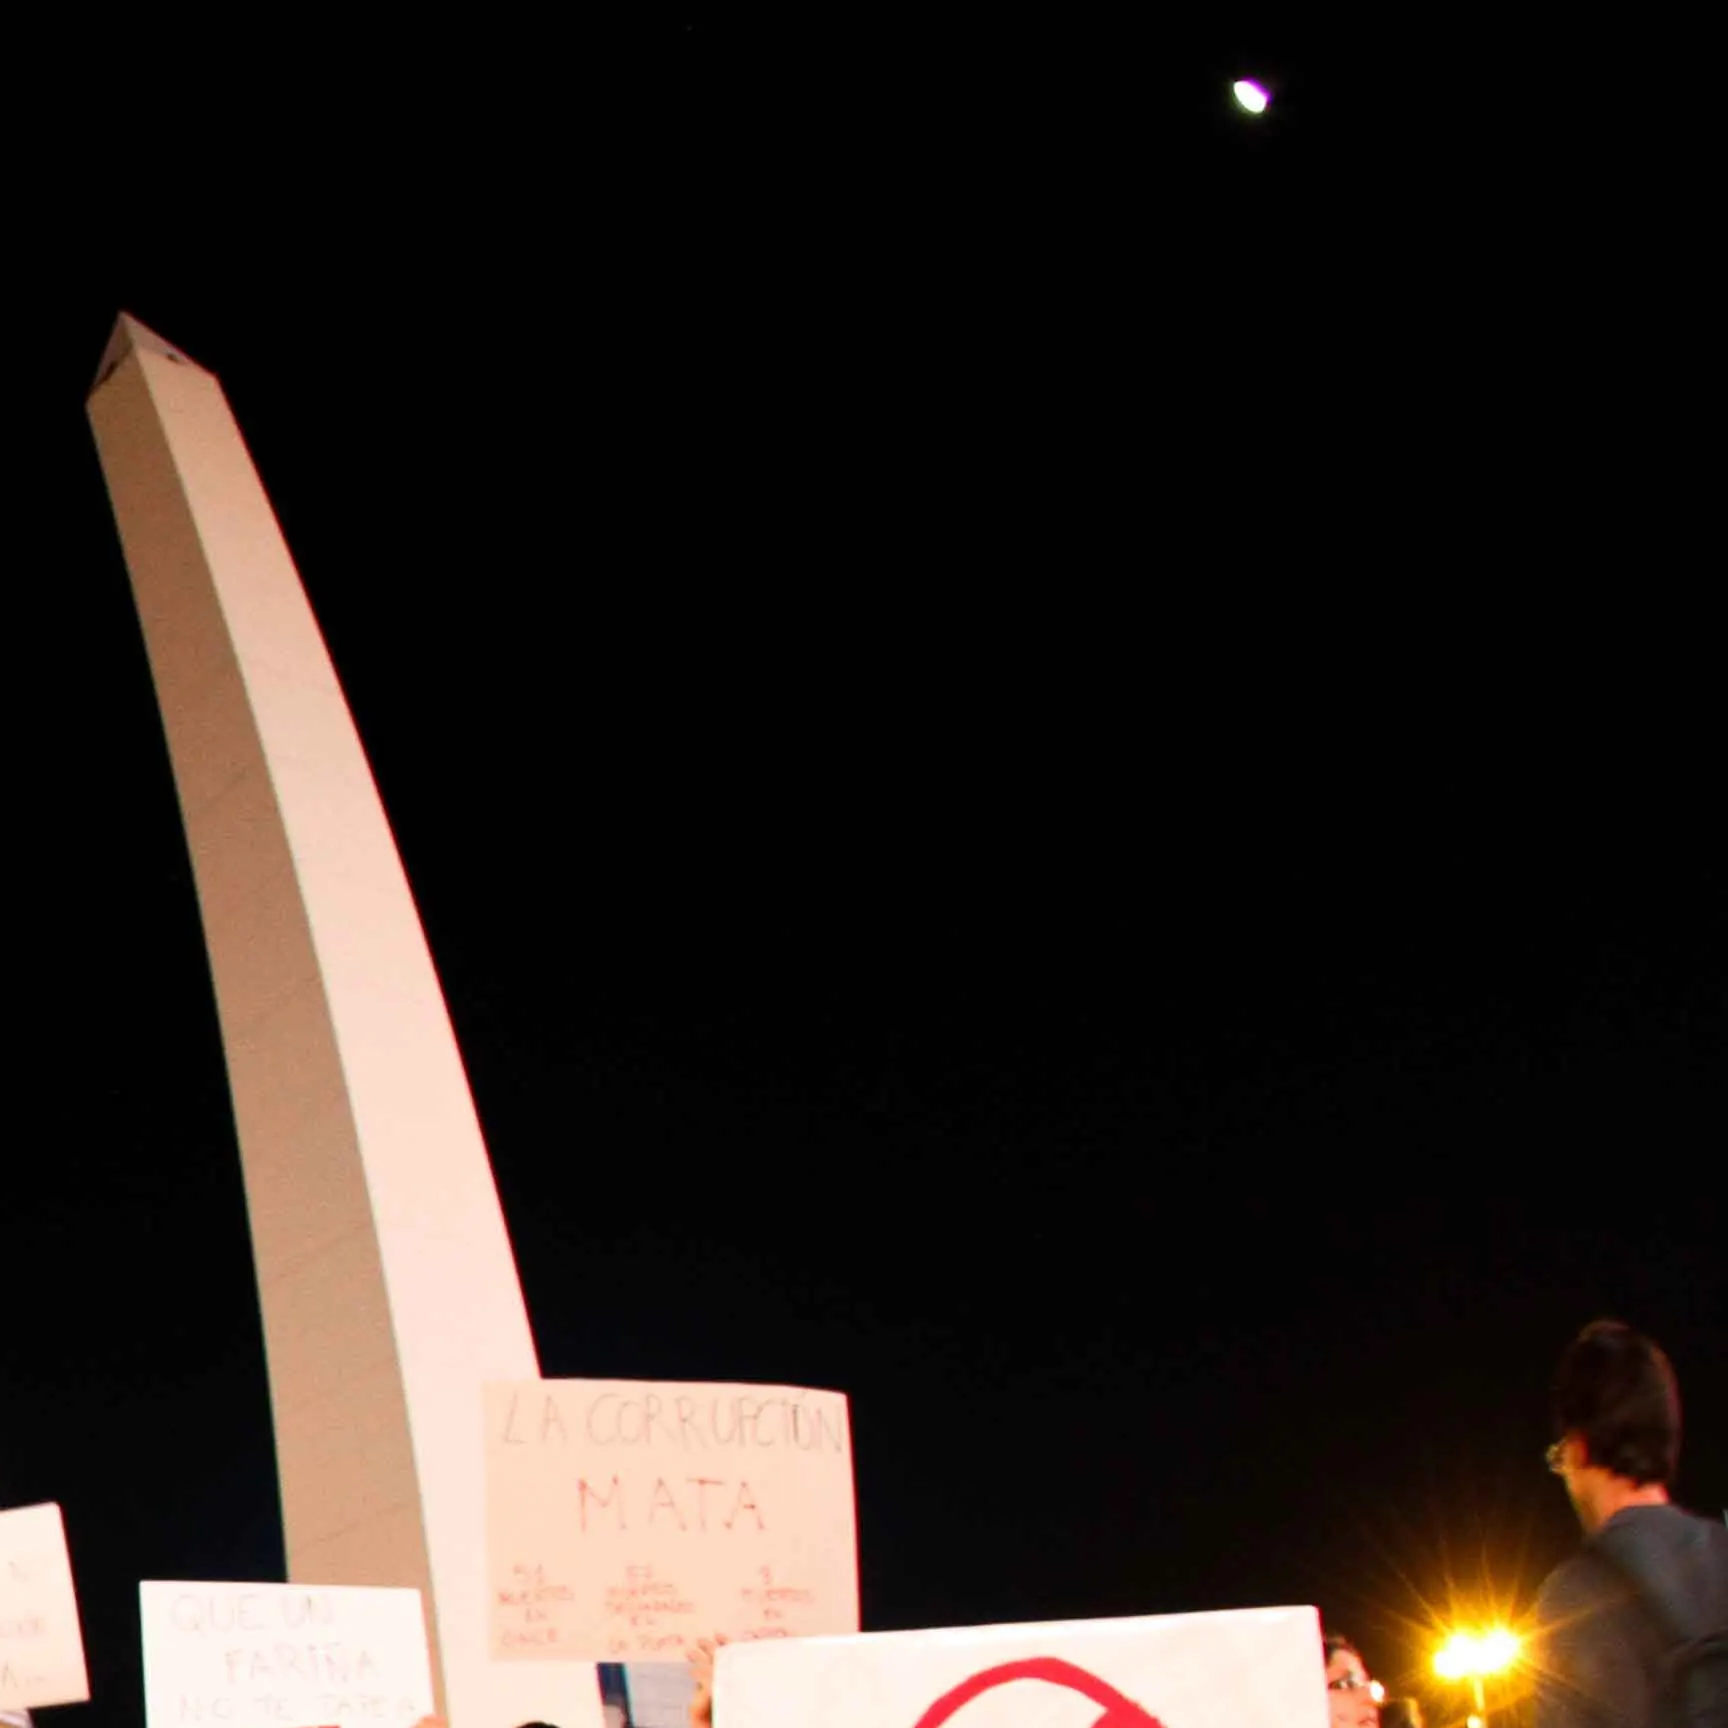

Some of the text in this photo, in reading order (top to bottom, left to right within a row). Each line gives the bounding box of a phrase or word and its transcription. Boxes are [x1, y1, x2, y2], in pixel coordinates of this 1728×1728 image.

[501, 1389, 569, 1446] LA
[576, 1473, 769, 1535] MATA
[169, 1594, 271, 1640] QUE
